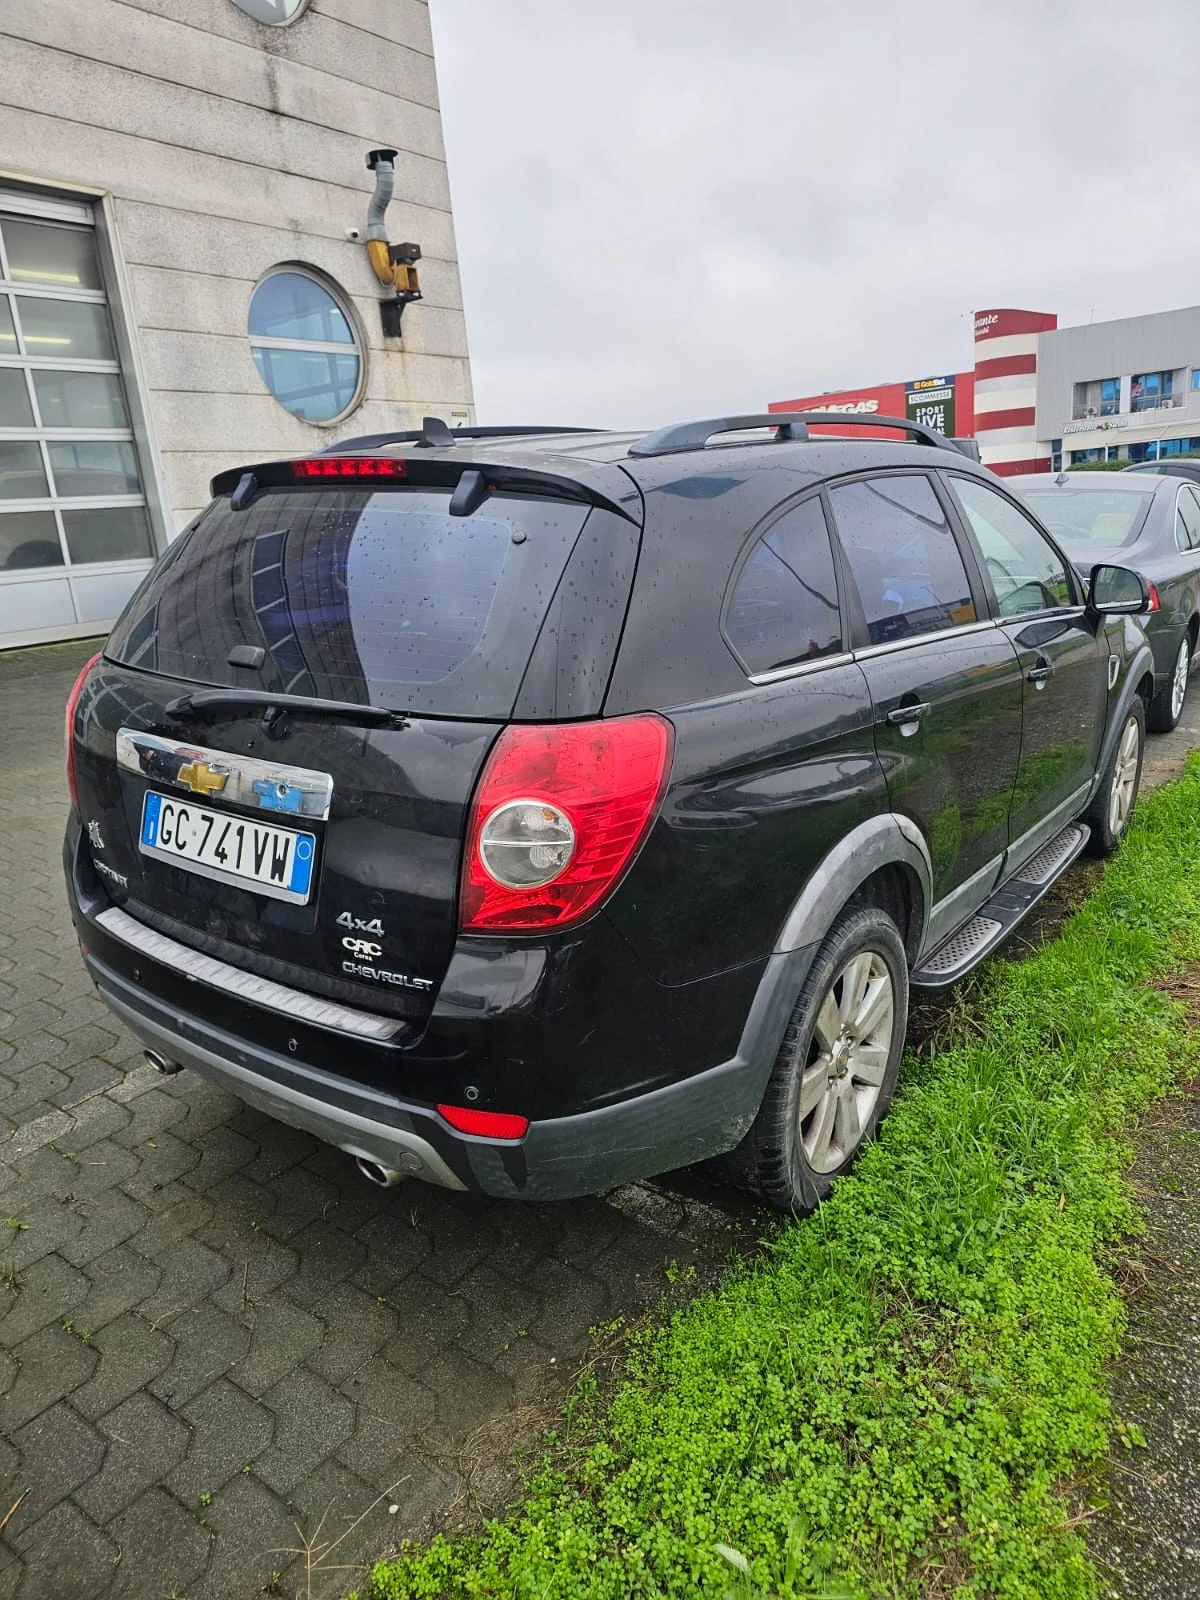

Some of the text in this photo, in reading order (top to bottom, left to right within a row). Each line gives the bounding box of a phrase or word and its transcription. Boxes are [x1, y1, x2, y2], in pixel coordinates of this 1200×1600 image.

[910, 391, 950, 402] SCOMMESSE
[916, 405, 945, 417] SPORT
[335, 911, 385, 937] 4x4
[342, 937, 383, 956] CRC
[342, 961, 434, 991] CHEVROLET
